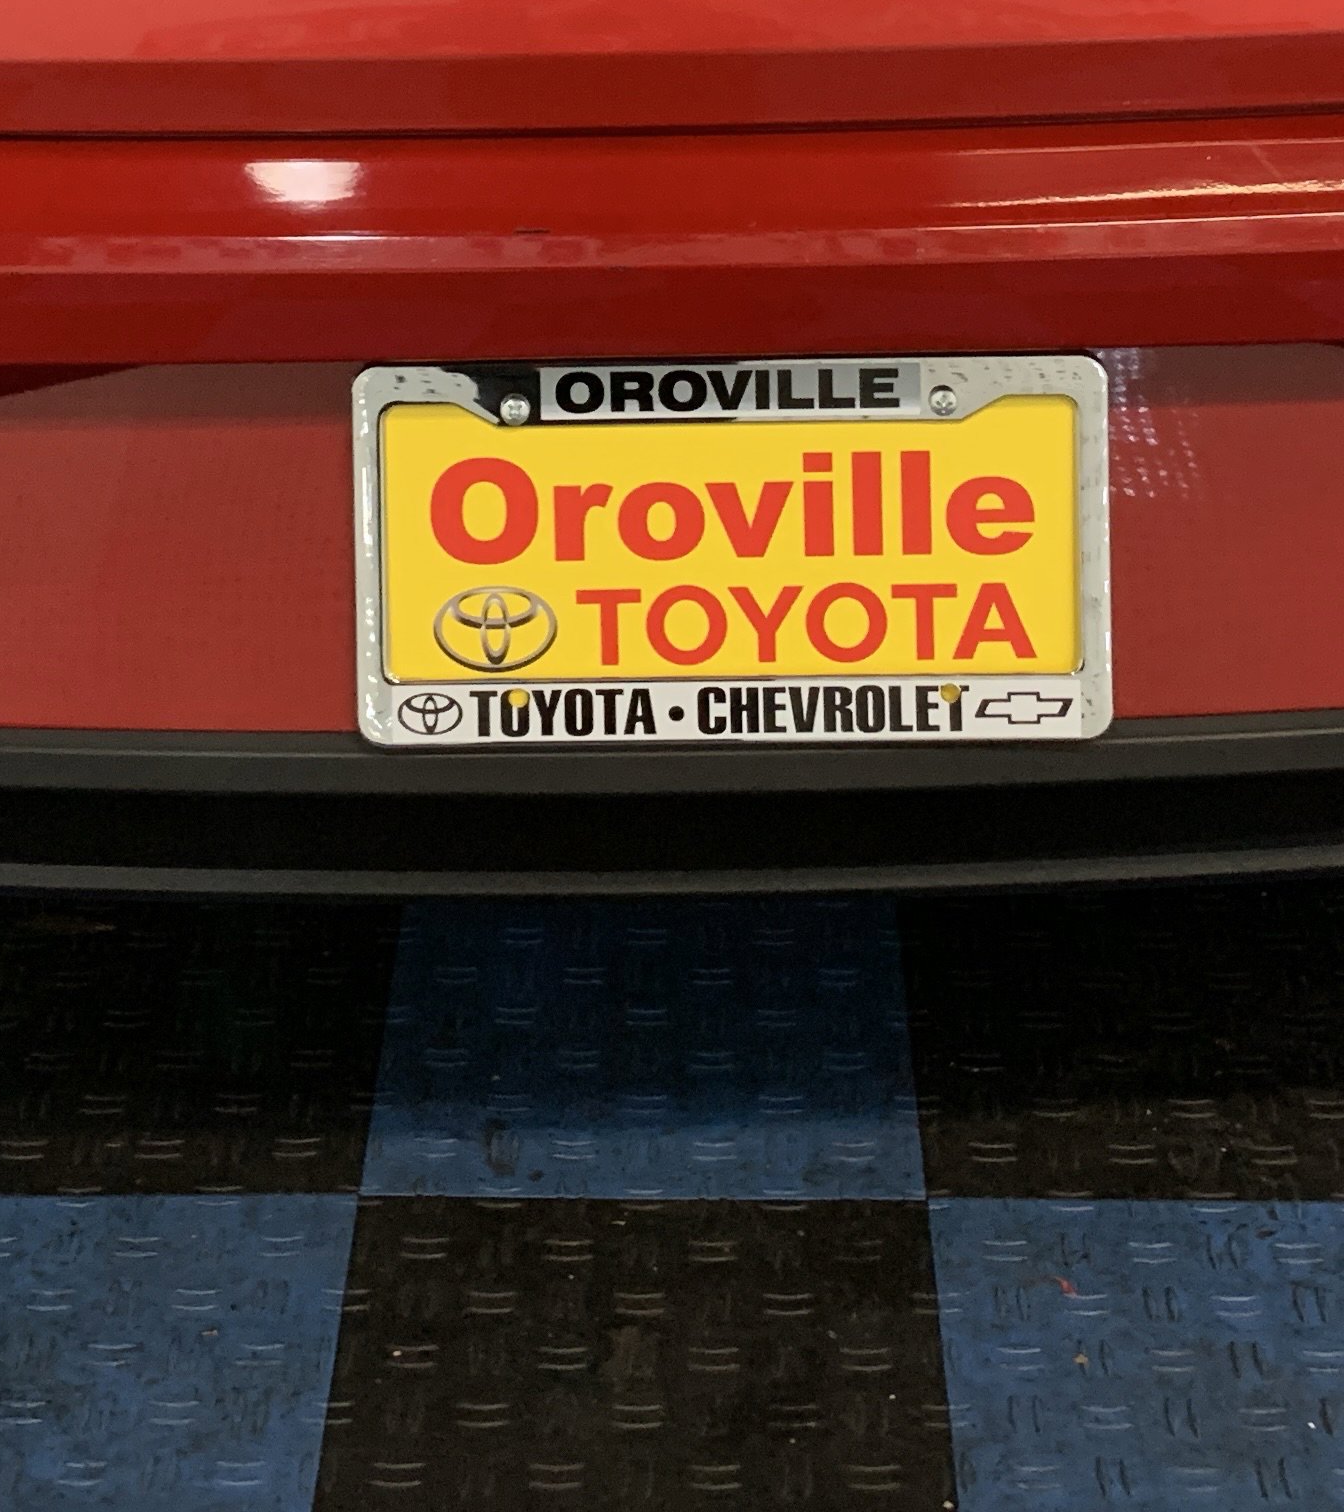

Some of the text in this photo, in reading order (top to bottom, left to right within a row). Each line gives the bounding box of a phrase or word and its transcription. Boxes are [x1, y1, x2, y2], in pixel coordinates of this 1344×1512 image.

[554, 367, 902, 415] OROVILLE
[429, 449, 1036, 566] Oroville
[575, 581, 1038, 667] TOYOTA
[468, 683, 971, 738] TOYOTA CHEVROLET
